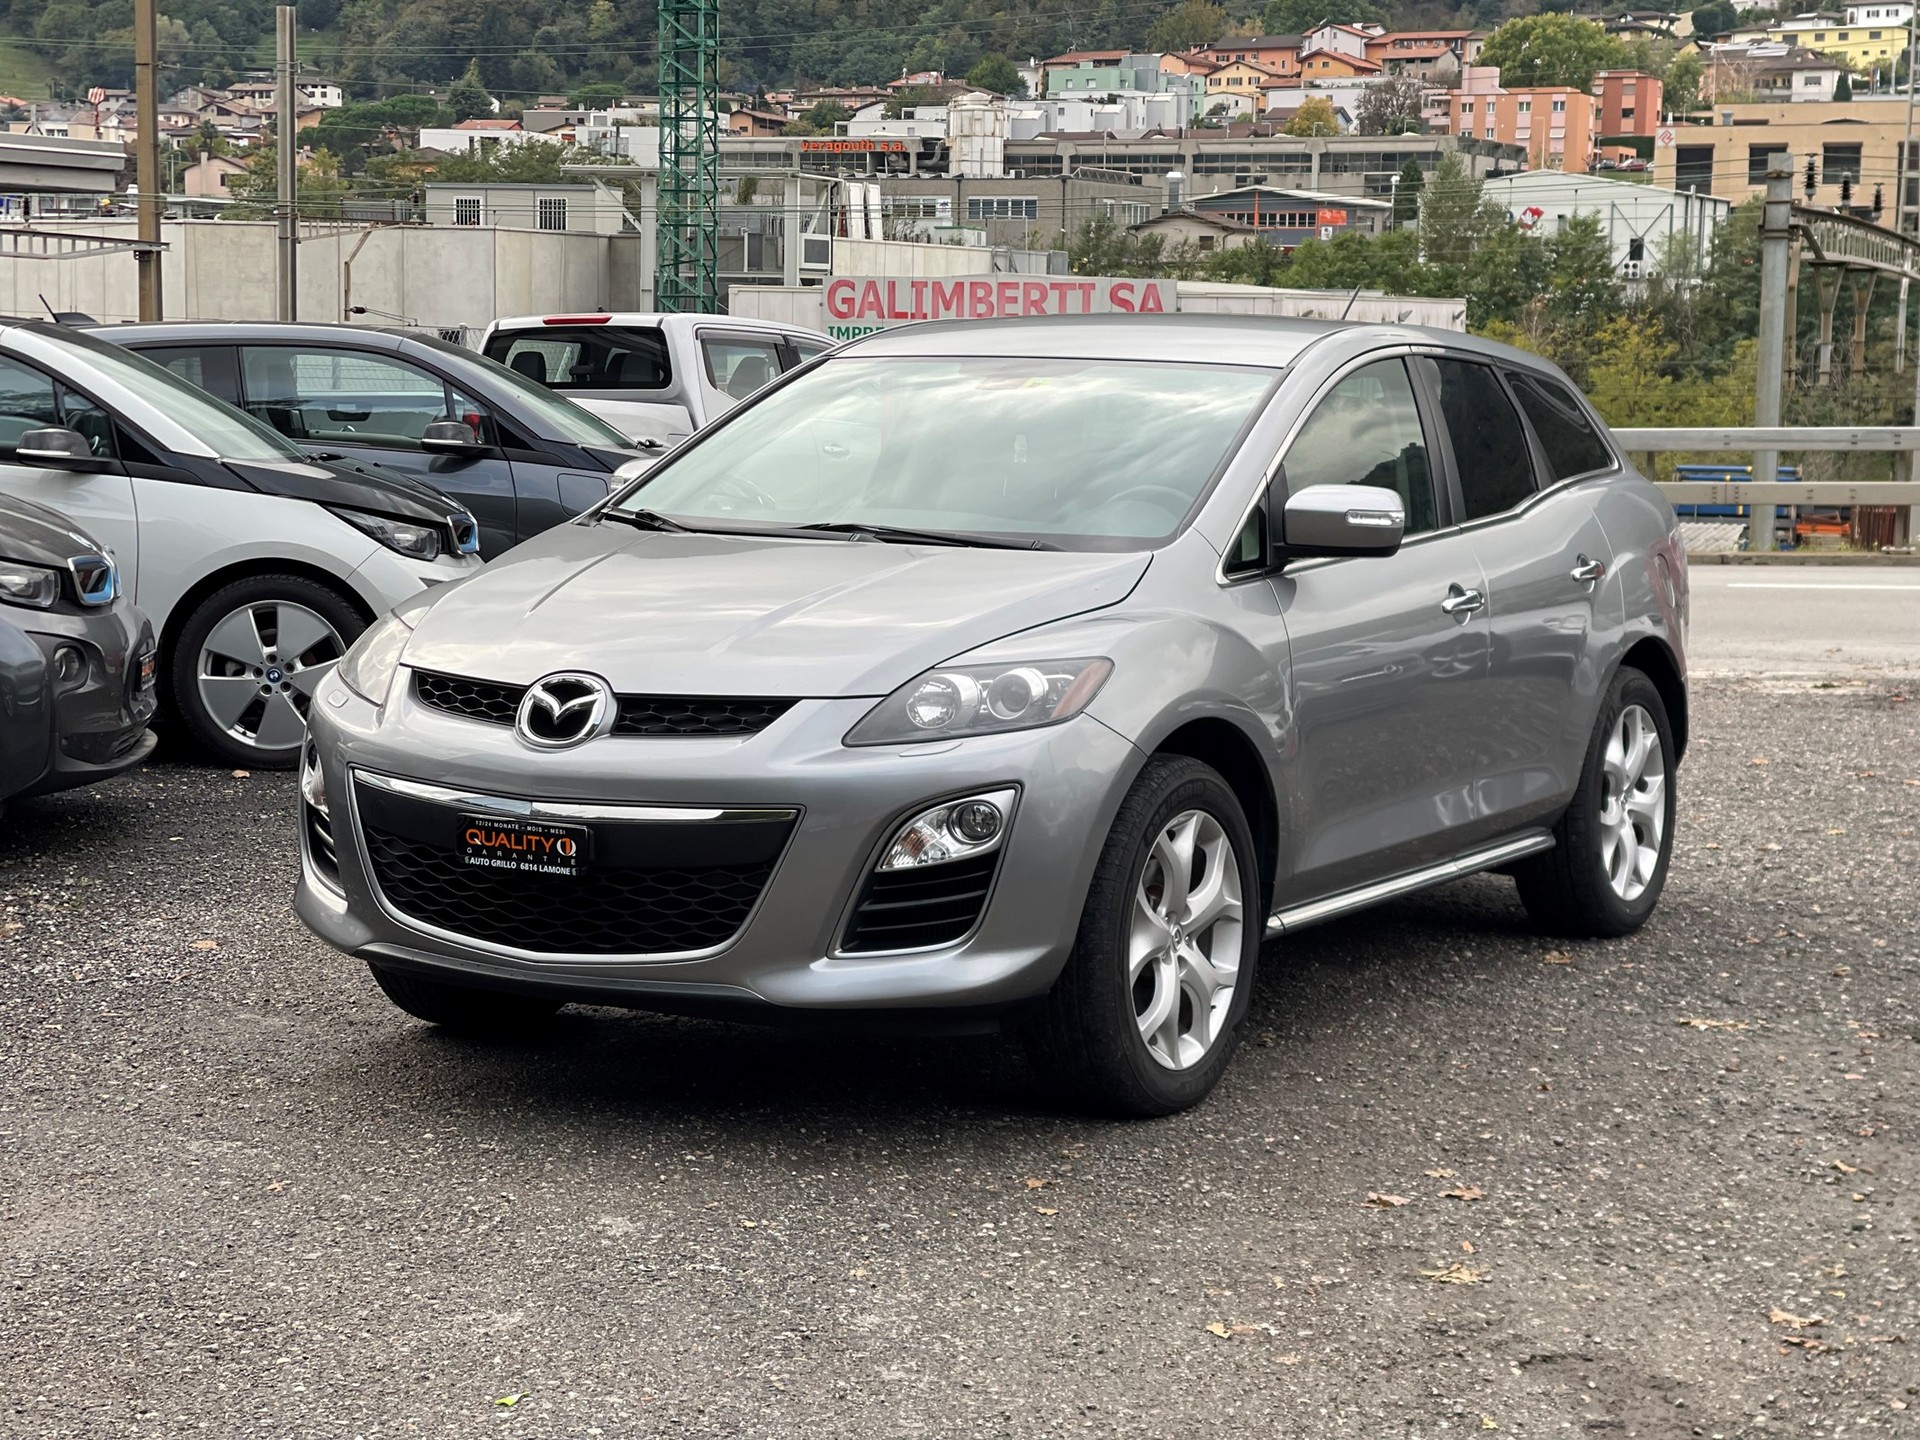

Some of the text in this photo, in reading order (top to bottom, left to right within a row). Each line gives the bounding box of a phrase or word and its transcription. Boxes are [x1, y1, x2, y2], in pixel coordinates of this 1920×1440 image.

[801, 139, 907, 153] veragouth s.a.
[827, 279, 1164, 320] GALIMBERTI SA
[828, 326, 885, 340] IMPR
[494, 822, 519, 830] MONATE
[466, 828, 554, 853] QUALITY
[466, 847, 576, 865] GARANTIE
[469, 857, 571, 875] AUTO GRILLO 6814 LAMONE
